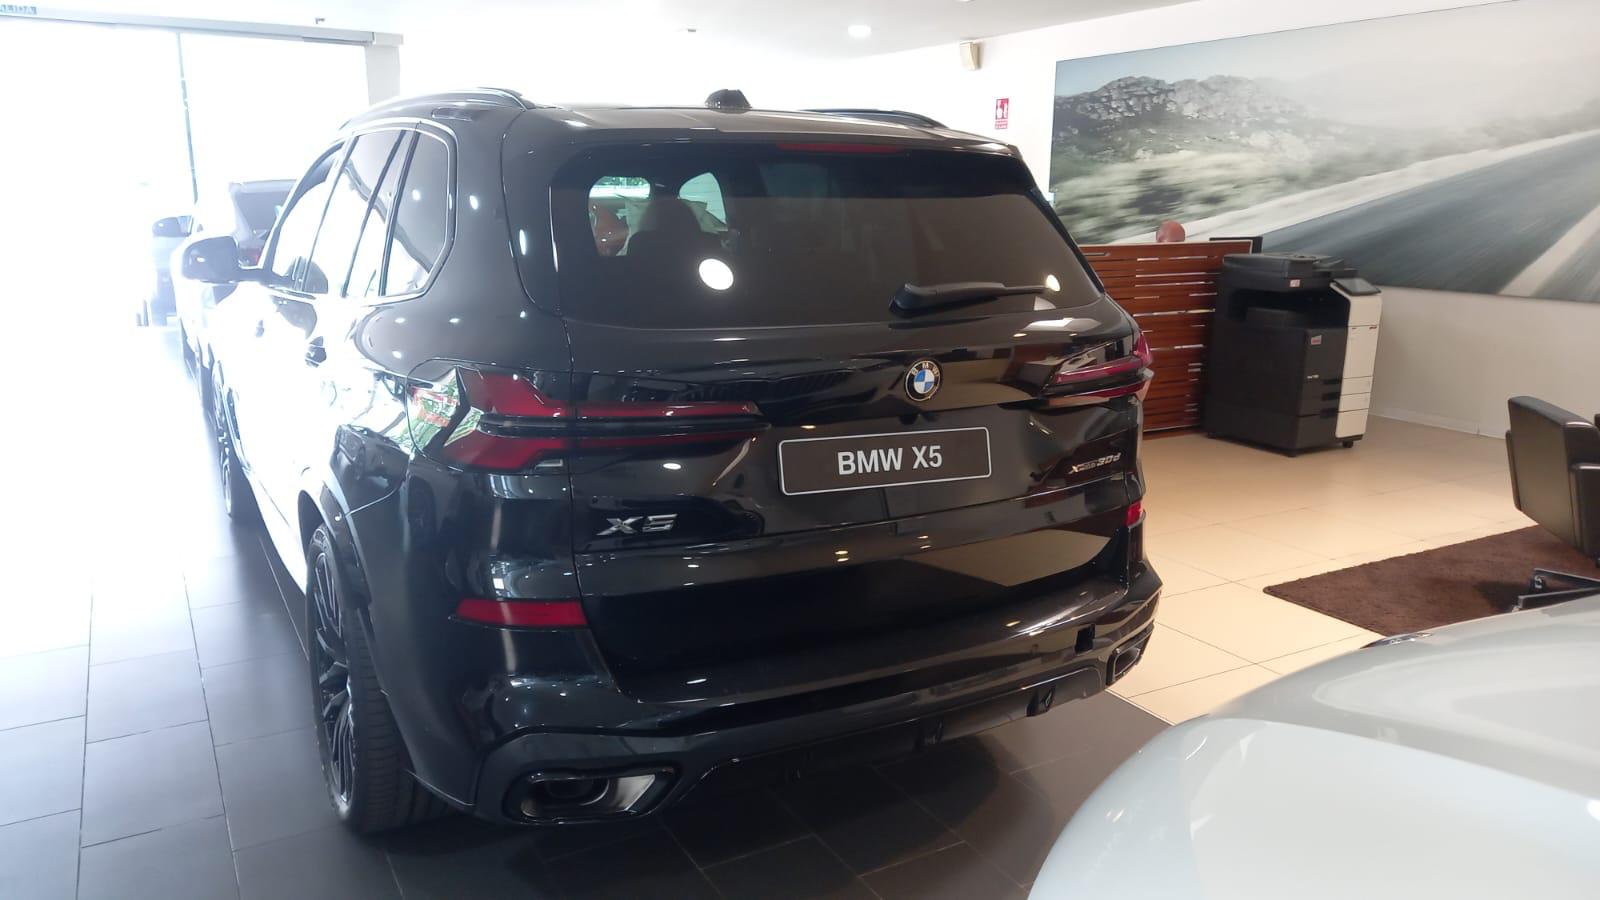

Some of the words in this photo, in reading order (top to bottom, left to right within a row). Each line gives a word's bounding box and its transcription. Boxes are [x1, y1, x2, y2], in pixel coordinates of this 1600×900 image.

[837, 447, 904, 476] BMW
[911, 445, 943, 470] X5
[596, 513, 678, 536] X5
